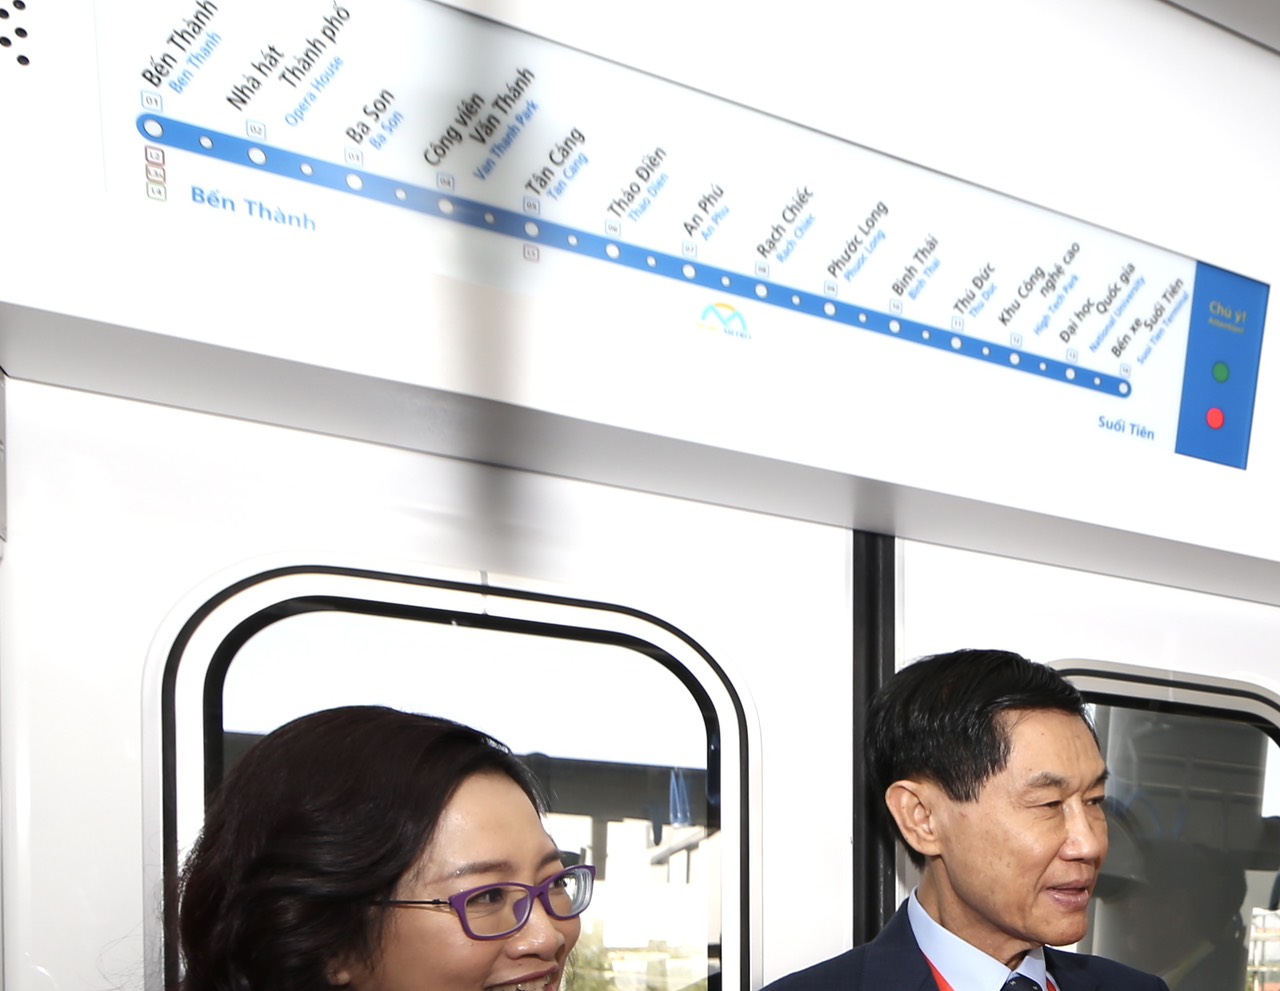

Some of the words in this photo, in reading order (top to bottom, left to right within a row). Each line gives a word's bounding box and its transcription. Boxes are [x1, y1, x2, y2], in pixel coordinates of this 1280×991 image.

[141, 54, 178, 88] Bến
[166, 0, 219, 52] Thành
[168, 69, 195, 94] Ben
[186, 31, 222, 69] Thanh
[278, 38, 328, 88] Thành
[320, 0, 351, 44] phố
[226, 74, 262, 111] Nhà
[250, 44, 285, 78] hát
[284, 91, 317, 126] Opera
[310, 56, 343, 93] House
[345, 121, 371, 144] Ba
[363, 88, 395, 123] Son
[381, 111, 404, 134] Son
[423, 124, 463, 166] Công
[455, 92, 485, 128] viên
[525, 165, 556, 196] Tân
[191, 185, 236, 212] Bến
[243, 197, 317, 232] Thành
[683, 213, 704, 238] An
[698, 182, 725, 215] Phú
[857, 200, 889, 236] Long
[1062, 241, 1081, 266] cao
[1119, 261, 1136, 286] gia
[998, 298, 1021, 327] Khu
[1129, 317, 1143, 336] xe
[1098, 414, 1126, 433] Suối
[1129, 422, 1156, 441] Tiên
